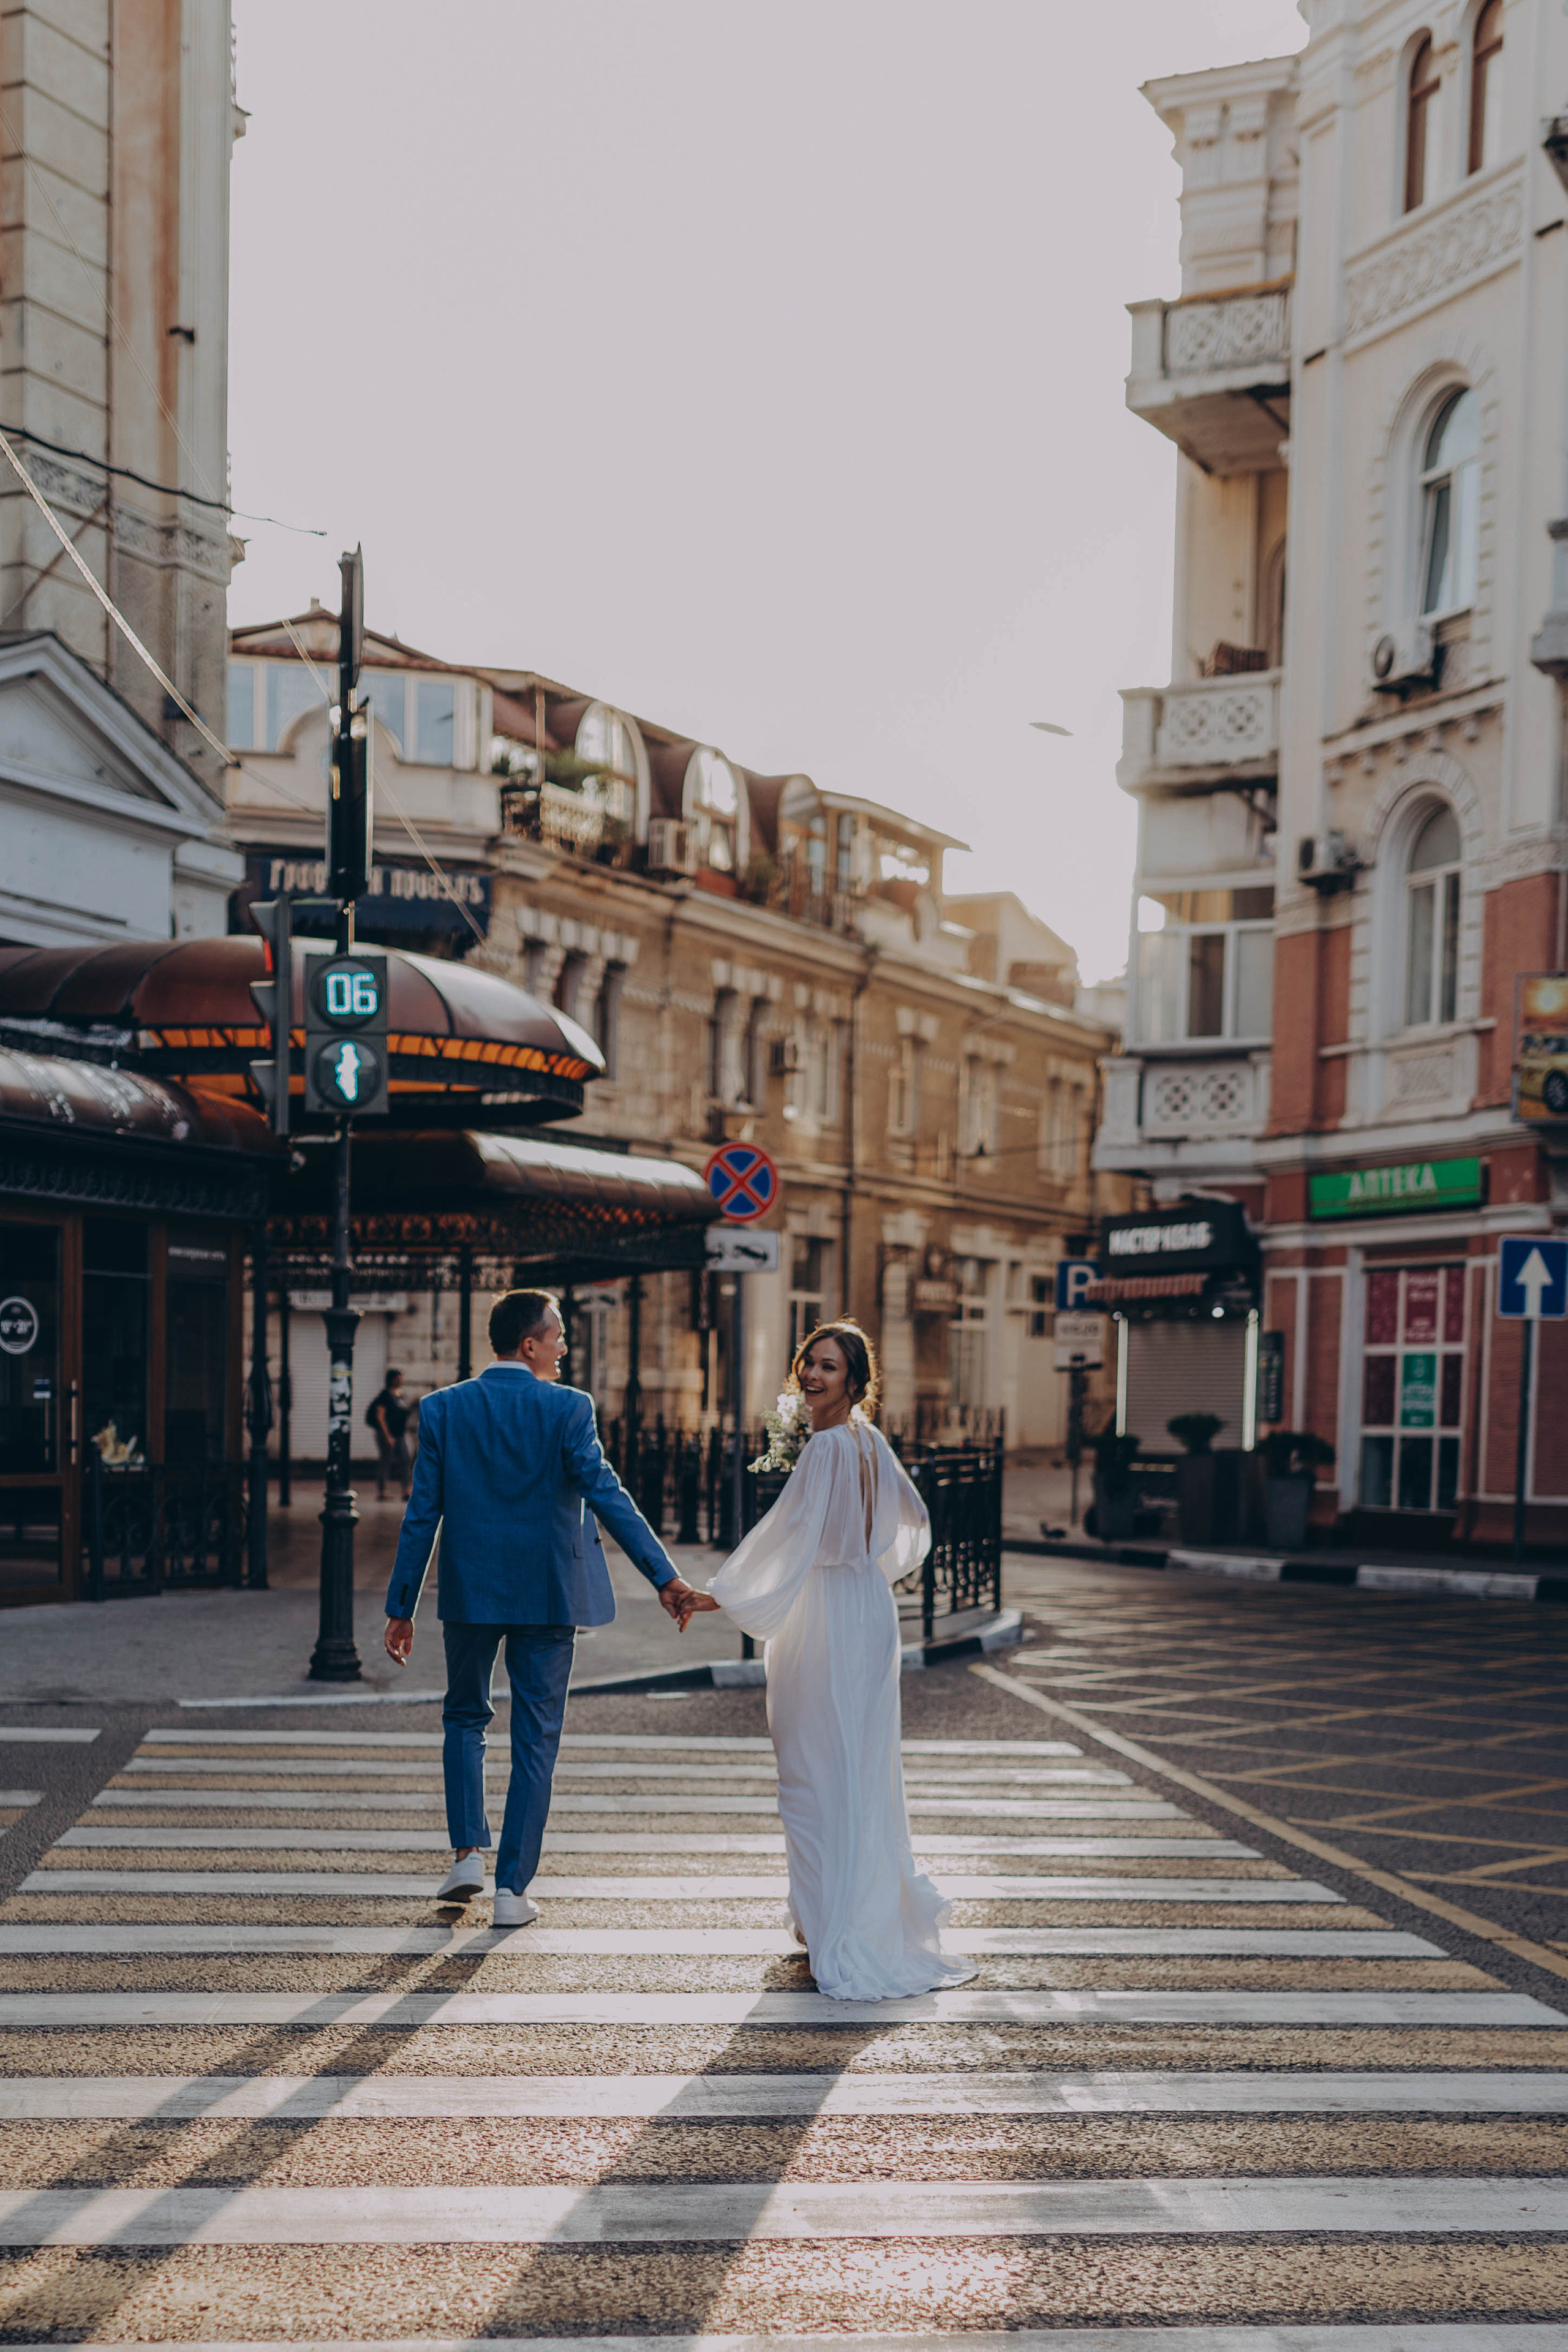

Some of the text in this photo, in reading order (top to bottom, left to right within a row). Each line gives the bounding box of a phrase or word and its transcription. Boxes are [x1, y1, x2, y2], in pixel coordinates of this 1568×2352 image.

[326, 972, 377, 1015] 06
[1348, 1163, 1438, 1199] АПТЕКА
[1067, 1264, 1095, 1306] P
